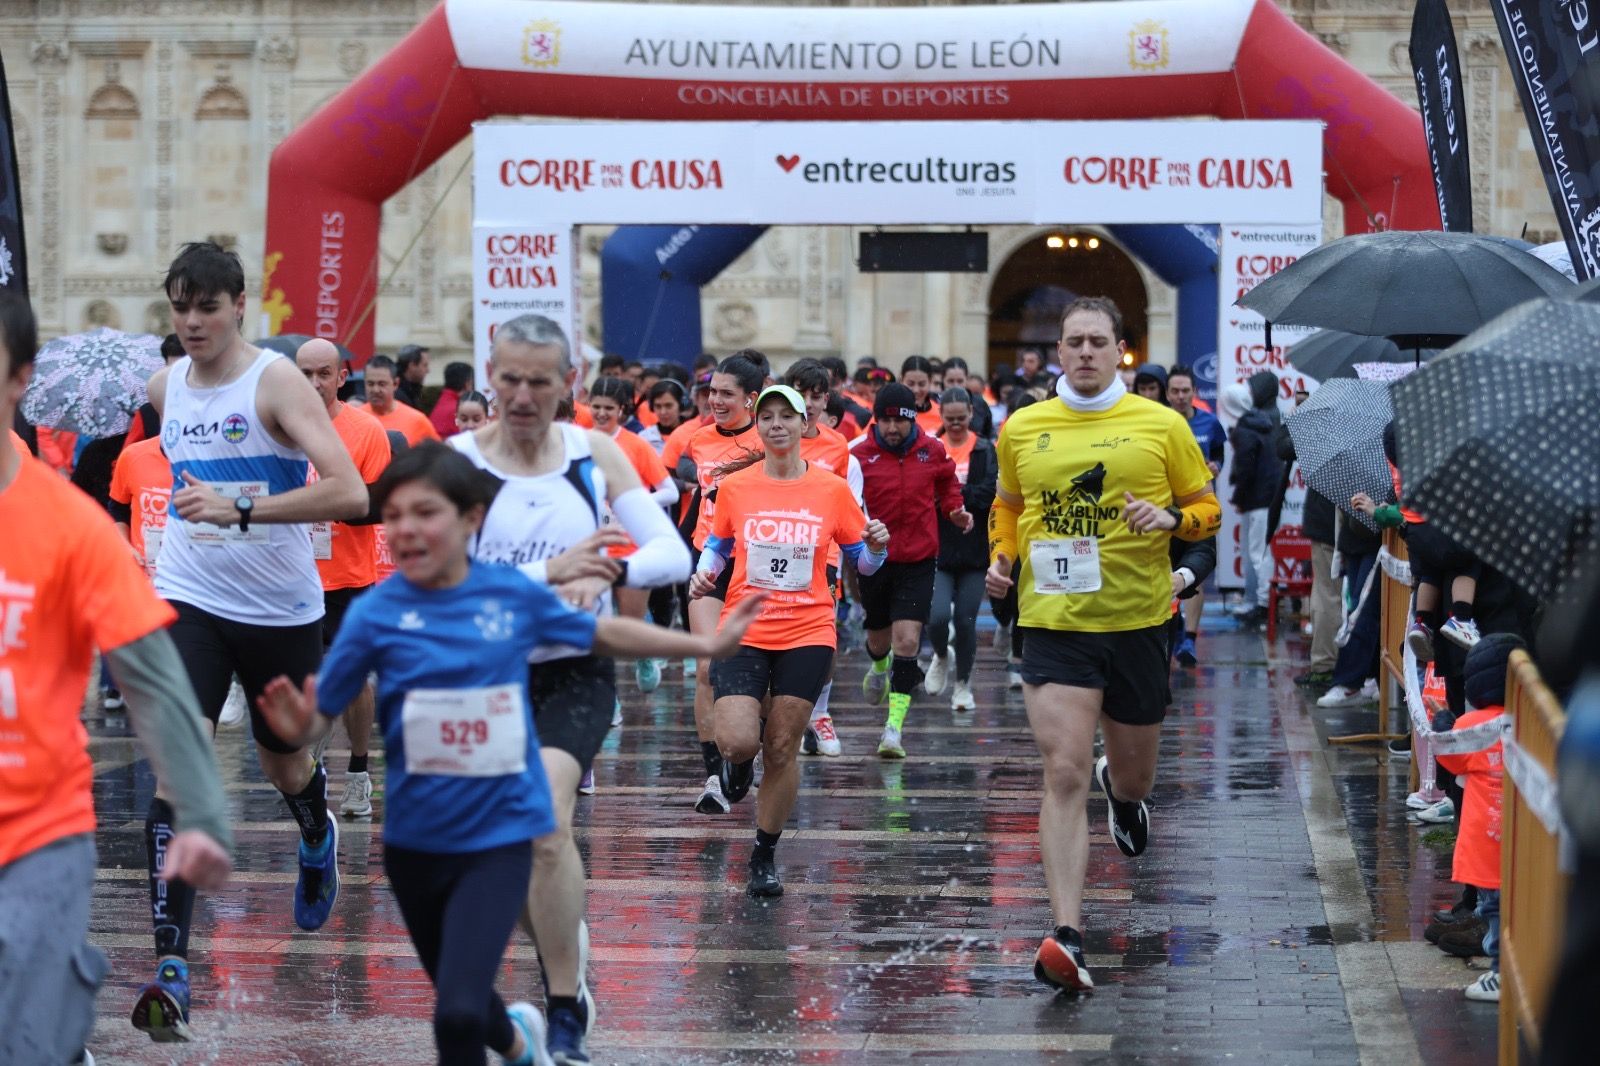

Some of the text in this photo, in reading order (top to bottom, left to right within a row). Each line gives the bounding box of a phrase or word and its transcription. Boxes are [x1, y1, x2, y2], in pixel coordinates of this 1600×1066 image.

[625, 32, 1060, 70] AYUNTAMIENTO DE LEÓN
[677, 83, 1010, 108] CONCEJALÍA DE DEPORTES
[499, 159, 596, 192] CORRE
[629, 159, 723, 190] CAUSA
[803, 157, 1016, 184] entreculturas
[1063, 156, 1162, 190] CORRE
[1167, 162, 1190, 176] POR
[1197, 158, 1293, 189] CAUSA
[487, 235, 558, 258] CORRE
[1240, 231, 1317, 243] entreculturas
[315, 210, 346, 339] DEPORTES
[488, 265, 558, 289] CAUSA
[490, 299, 565, 311] entreculturas
[744, 519, 822, 547] CORRE
[770, 558, 788, 574] 32
[440, 720, 489, 745] 529
[152, 822, 176, 920] Kalenji
